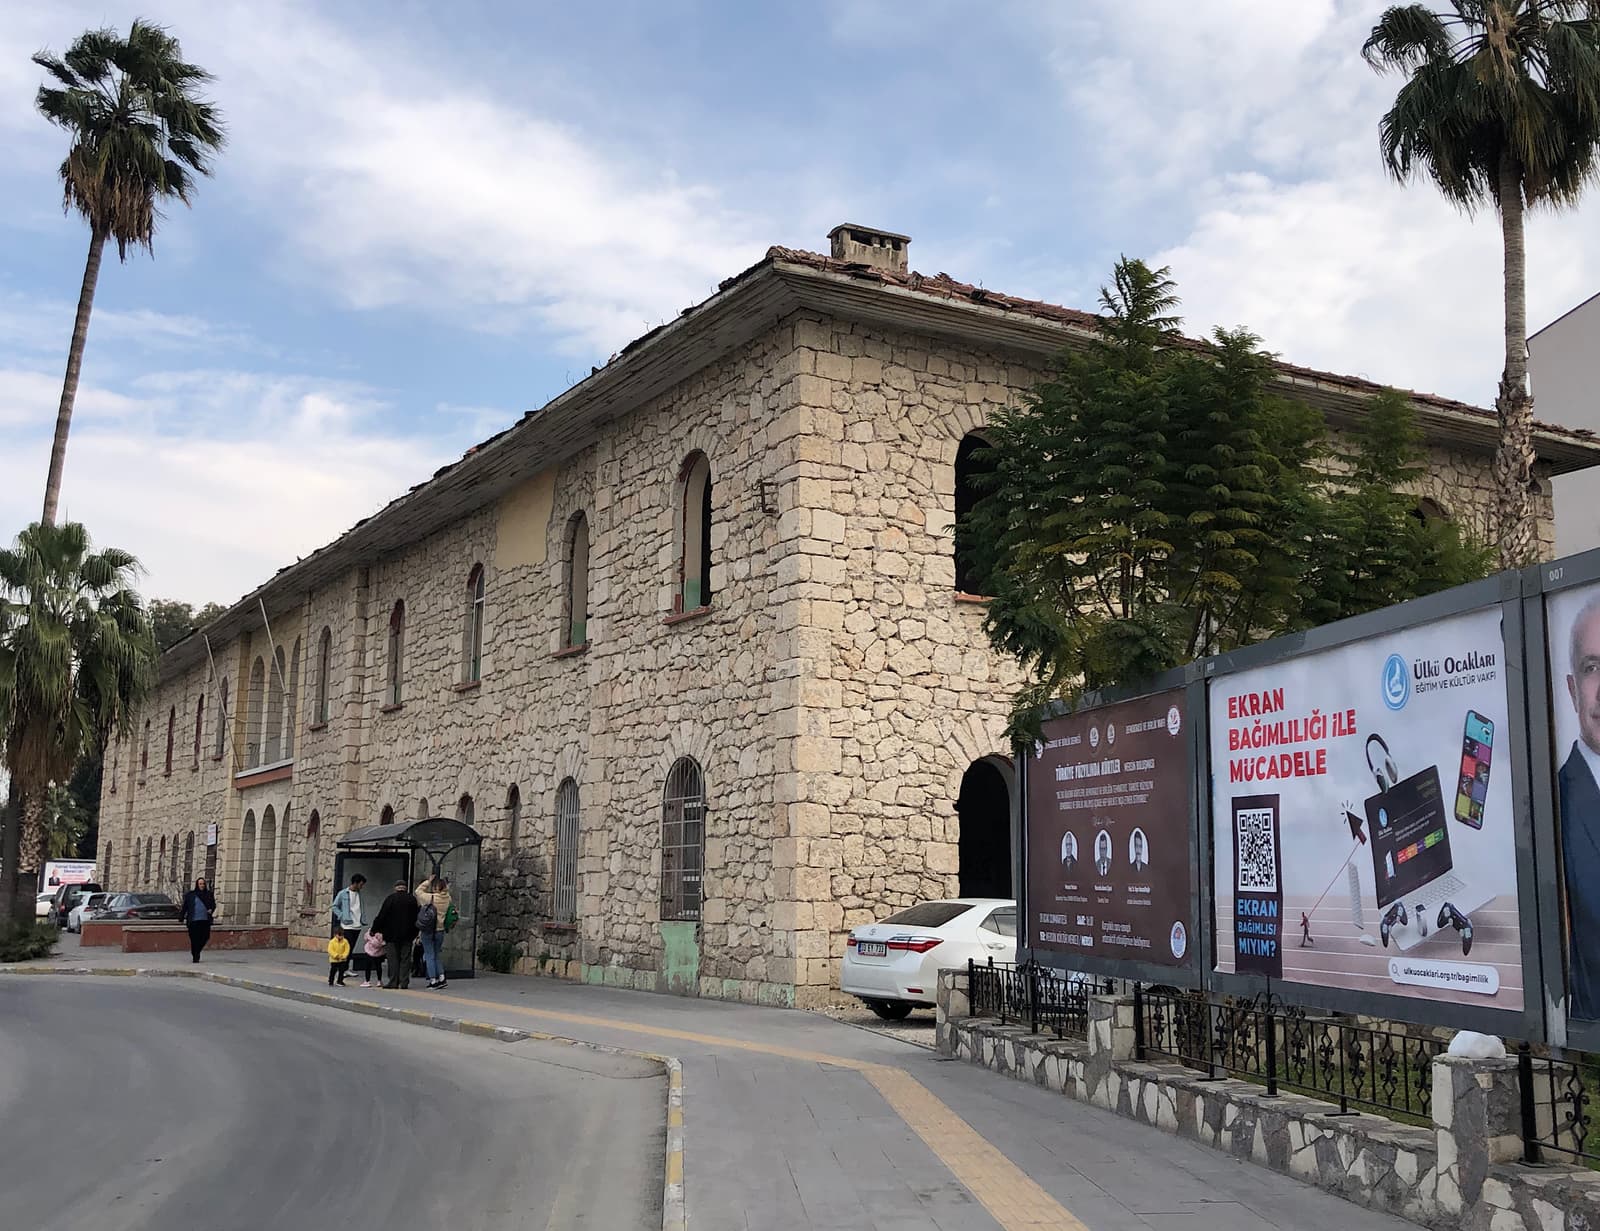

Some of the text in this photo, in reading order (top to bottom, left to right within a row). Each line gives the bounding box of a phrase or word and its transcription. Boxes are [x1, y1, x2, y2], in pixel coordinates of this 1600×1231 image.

[1549, 567, 1564, 581] 007
[1439, 679, 1449, 689] VE
[1449, 673, 1476, 688] KÜLTÜR
[1228, 687, 1284, 719] EKRAN
[1229, 709, 1327, 751] BAĞIMLILIĞI
[1229, 748, 1327, 783] MÜCADELE
[1237, 898, 1278, 918] EKRAN
[1237, 919, 1277, 936] BAĞIMLISI
[1238, 937, 1276, 957] MIYIM?
